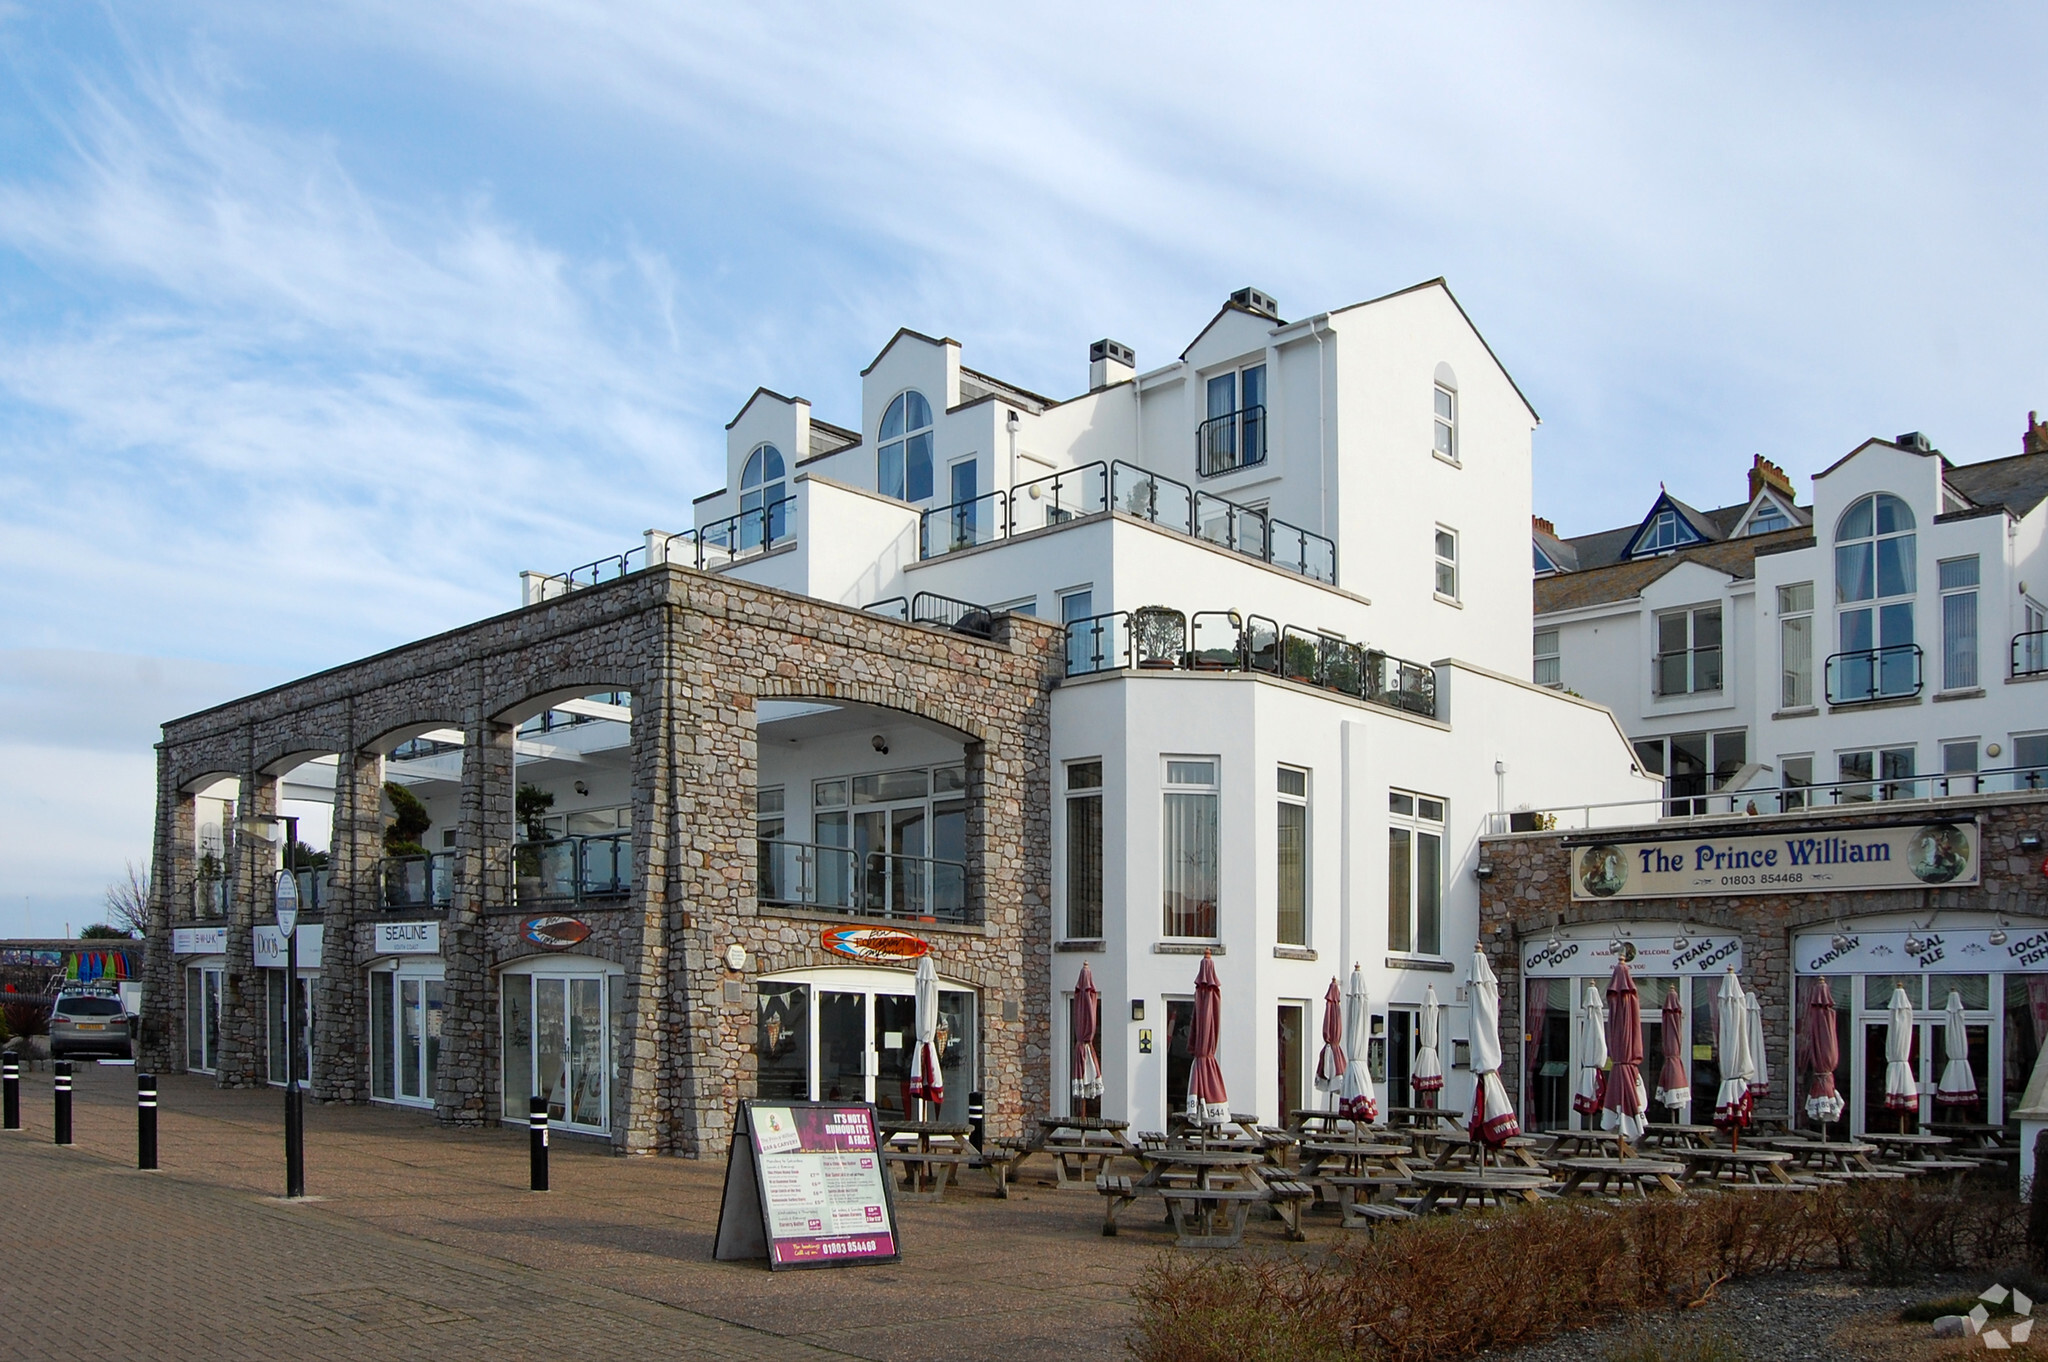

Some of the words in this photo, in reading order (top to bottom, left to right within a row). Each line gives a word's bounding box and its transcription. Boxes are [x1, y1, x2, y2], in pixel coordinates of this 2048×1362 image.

[1639, 847, 1683, 873] The
[1695, 845, 1777, 870] Prince
[1786, 837, 1891, 865] William
[1721, 875, 1755, 885] 01803
[1761, 873, 1803, 883] 854468
[386, 925, 427, 940] SEALINE
[1672, 938, 1713, 970] STEAKS
[1810, 936, 1859, 970] CARVERY
[1910, 934, 1945, 957] EAL
[1548, 944, 1578, 968] FOOD
[1698, 940, 1739, 971] BOOZE
[1919, 947, 1945, 968] ALE
[833, 1113, 847, 1124] IT'S
[847, 1113, 860, 1124] NOT
[861, 1113, 867, 1124] A
[825, 1124, 855, 1134] RUMOUR
[856, 1124, 869, 1134] IT'S
[777, 1139, 798, 1148] CARVERY
[848, 1135, 853, 1144] A
[854, 1135, 870, 1144] FACT
[822, 1243, 847, 1254] 01803
[847, 1240, 876, 1252] 854468
